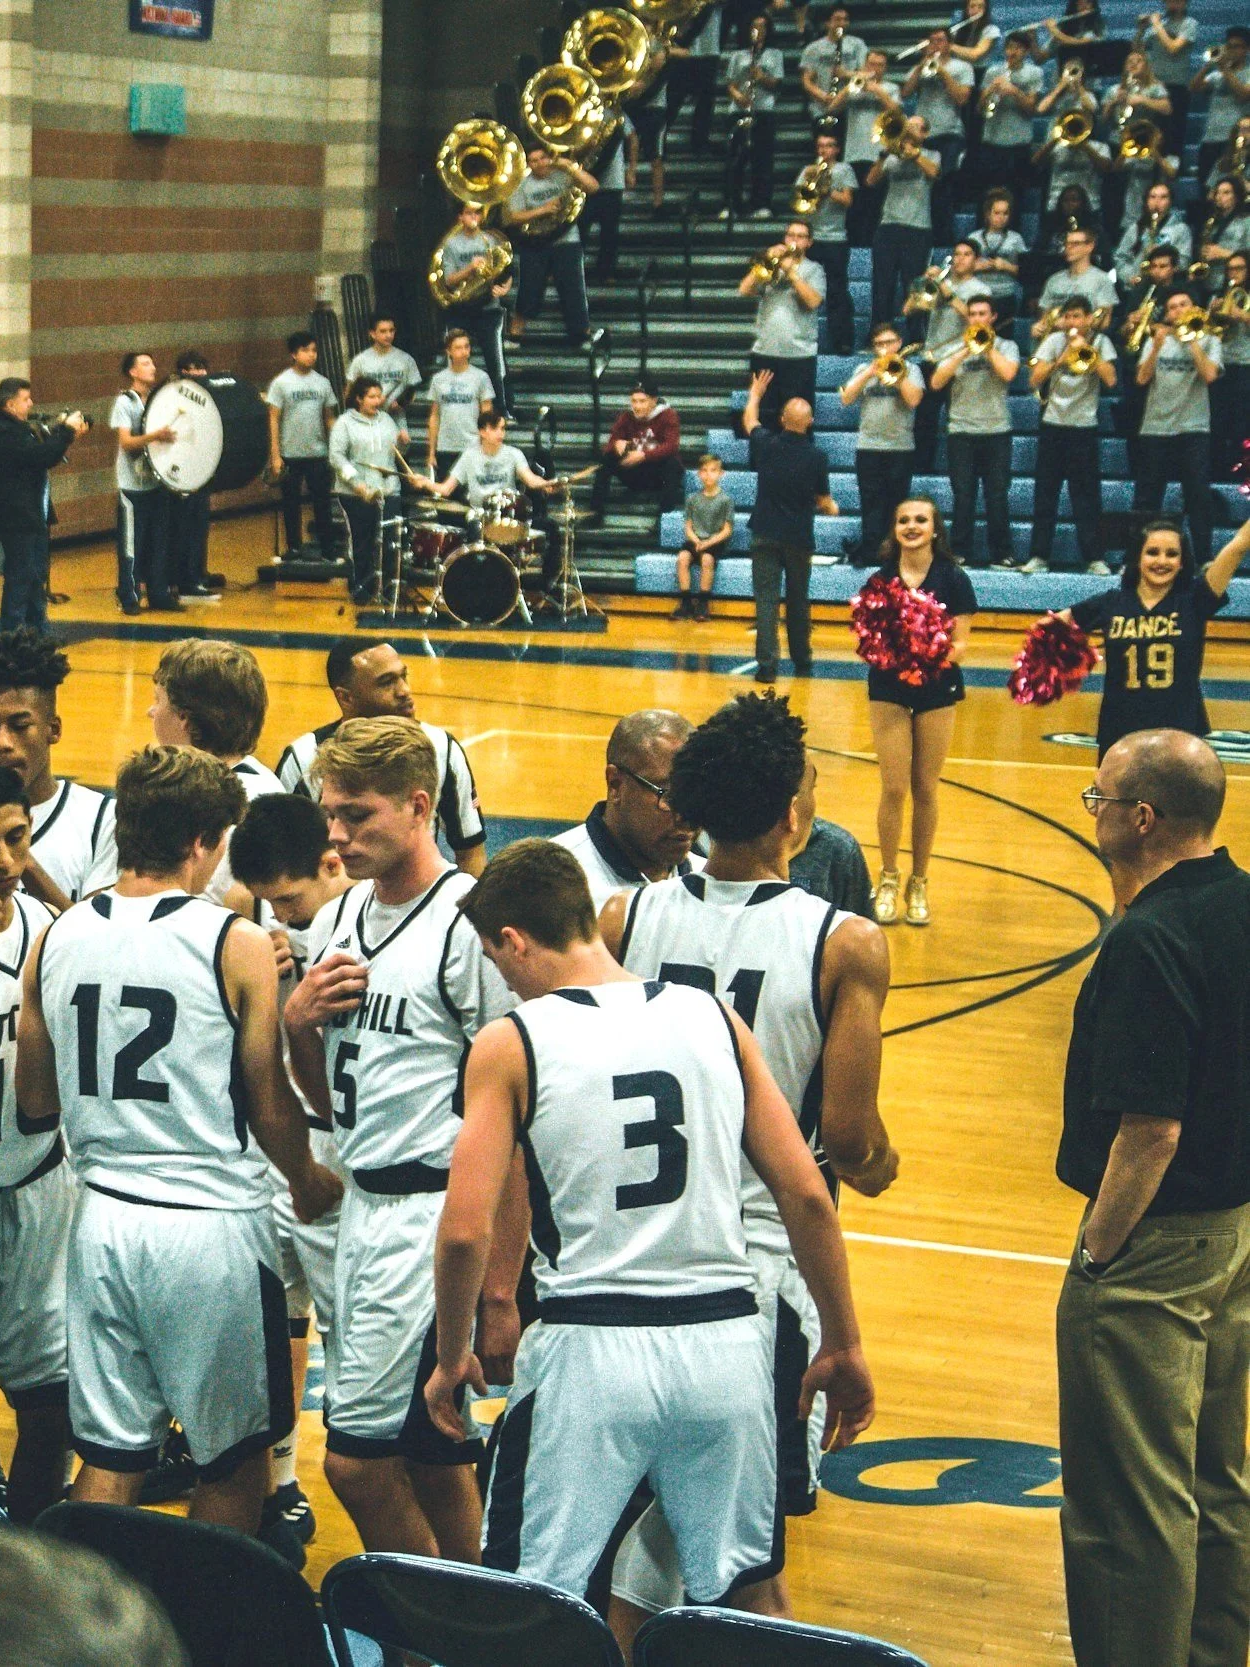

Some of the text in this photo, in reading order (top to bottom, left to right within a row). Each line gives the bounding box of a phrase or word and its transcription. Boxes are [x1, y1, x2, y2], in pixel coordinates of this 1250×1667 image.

[1109, 612, 1182, 639] DANCE
[1124, 643, 1175, 689] 19
[70, 983, 177, 1103] 12
[333, 1040, 361, 1130] 5
[612, 1070, 687, 1211] 3
